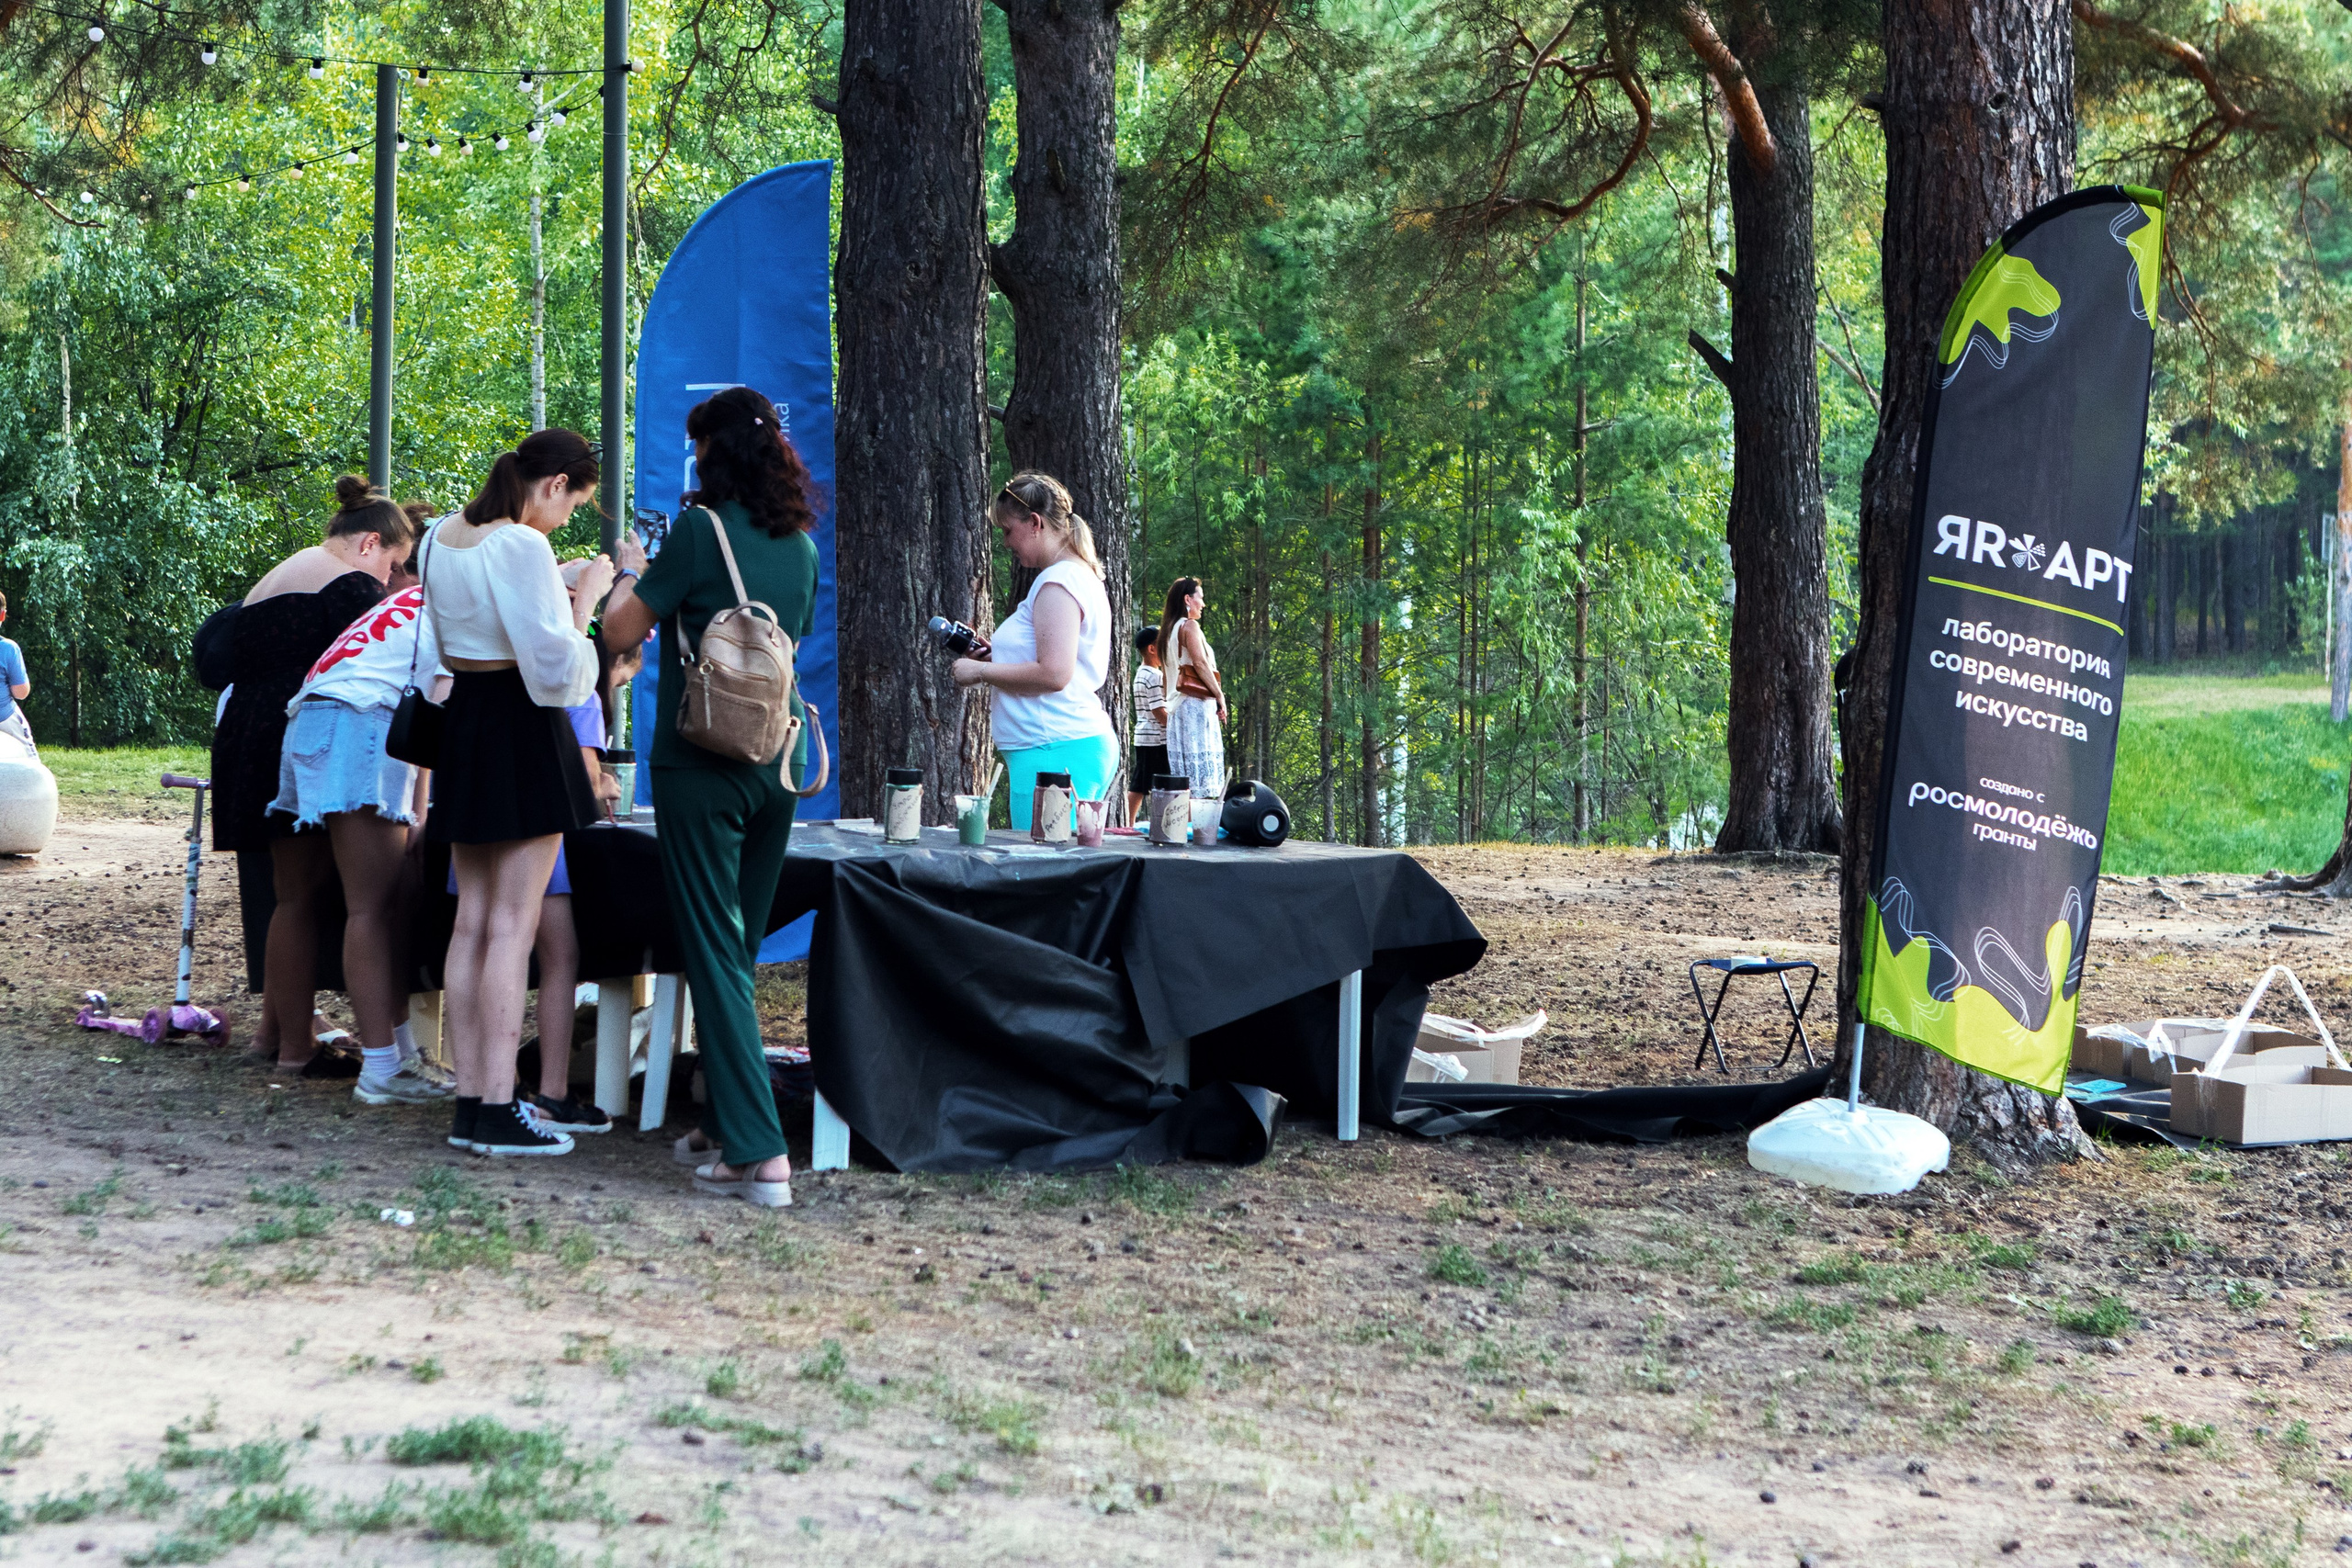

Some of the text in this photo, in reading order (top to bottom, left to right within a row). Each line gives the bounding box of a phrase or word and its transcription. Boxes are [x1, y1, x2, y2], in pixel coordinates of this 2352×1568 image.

[1941, 617, 2111, 680] лаборатория
[1929, 649, 2113, 716] современного
[1955, 690, 2088, 742] искусства
[1908, 782, 2098, 850] росмолодёжь
[1979, 777, 2046, 804] создано с
[1972, 822, 2037, 851] гранты
